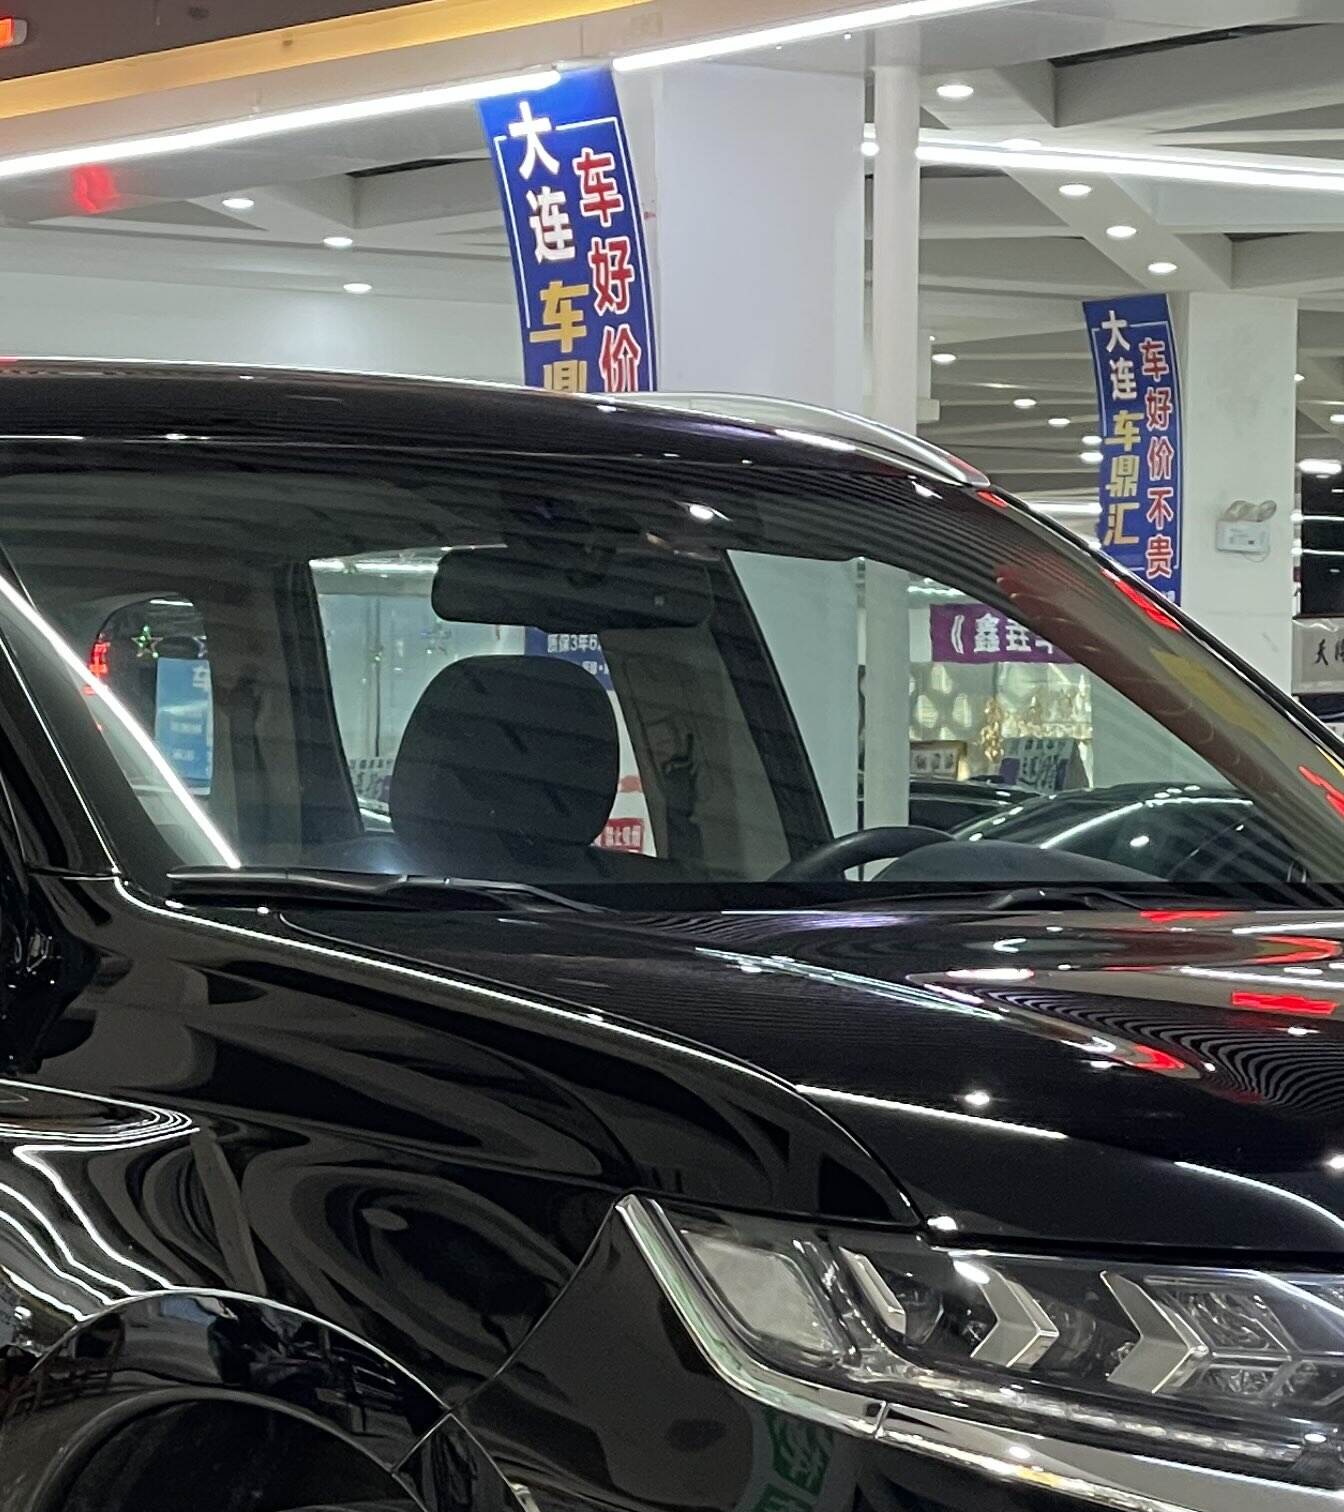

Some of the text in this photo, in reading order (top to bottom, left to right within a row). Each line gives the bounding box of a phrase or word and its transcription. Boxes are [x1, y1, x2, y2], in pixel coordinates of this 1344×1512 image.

[572, 147, 641, 392] 车好价
[1102, 310, 1144, 546] 大连车鼎汇
[1138, 336, 1174, 579] 车好价不贵
